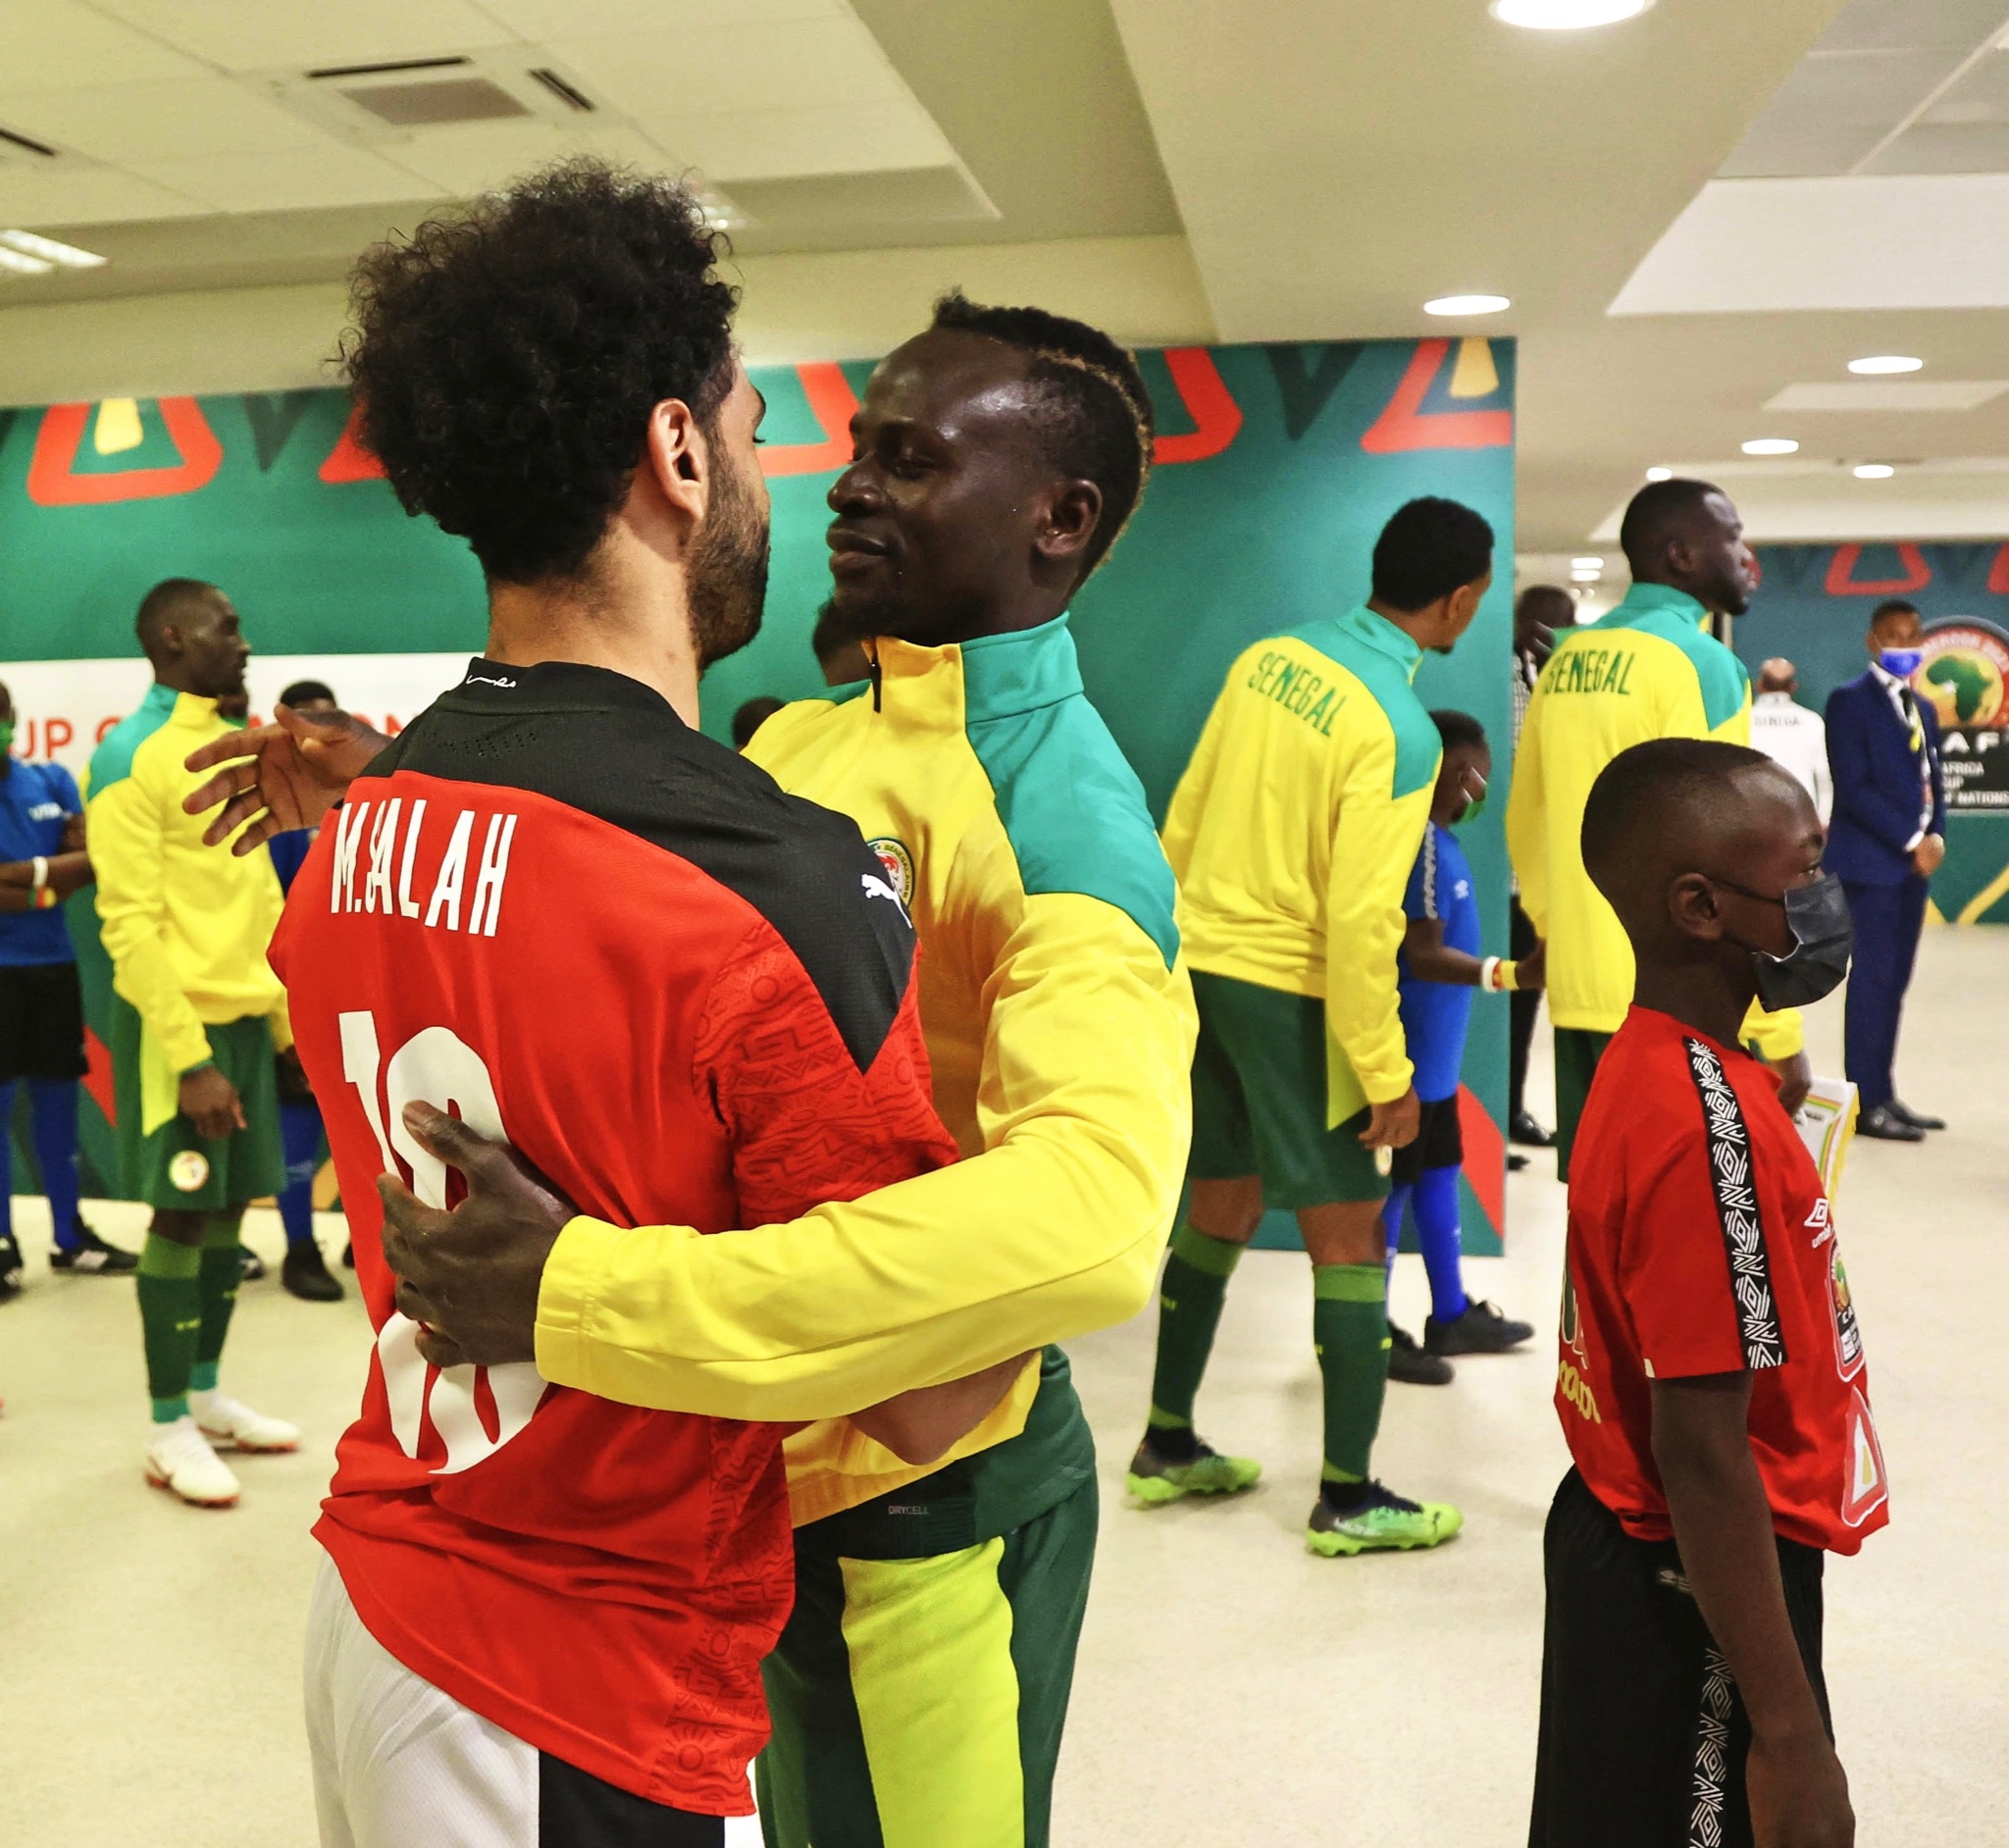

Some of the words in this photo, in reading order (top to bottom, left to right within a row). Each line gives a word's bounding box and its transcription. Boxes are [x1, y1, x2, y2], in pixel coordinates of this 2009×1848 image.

[1247, 651, 1348, 738] SENEGAL
[1544, 649, 1636, 695] SENEGAL
[888, 1505, 929, 1514] DRYCELL
